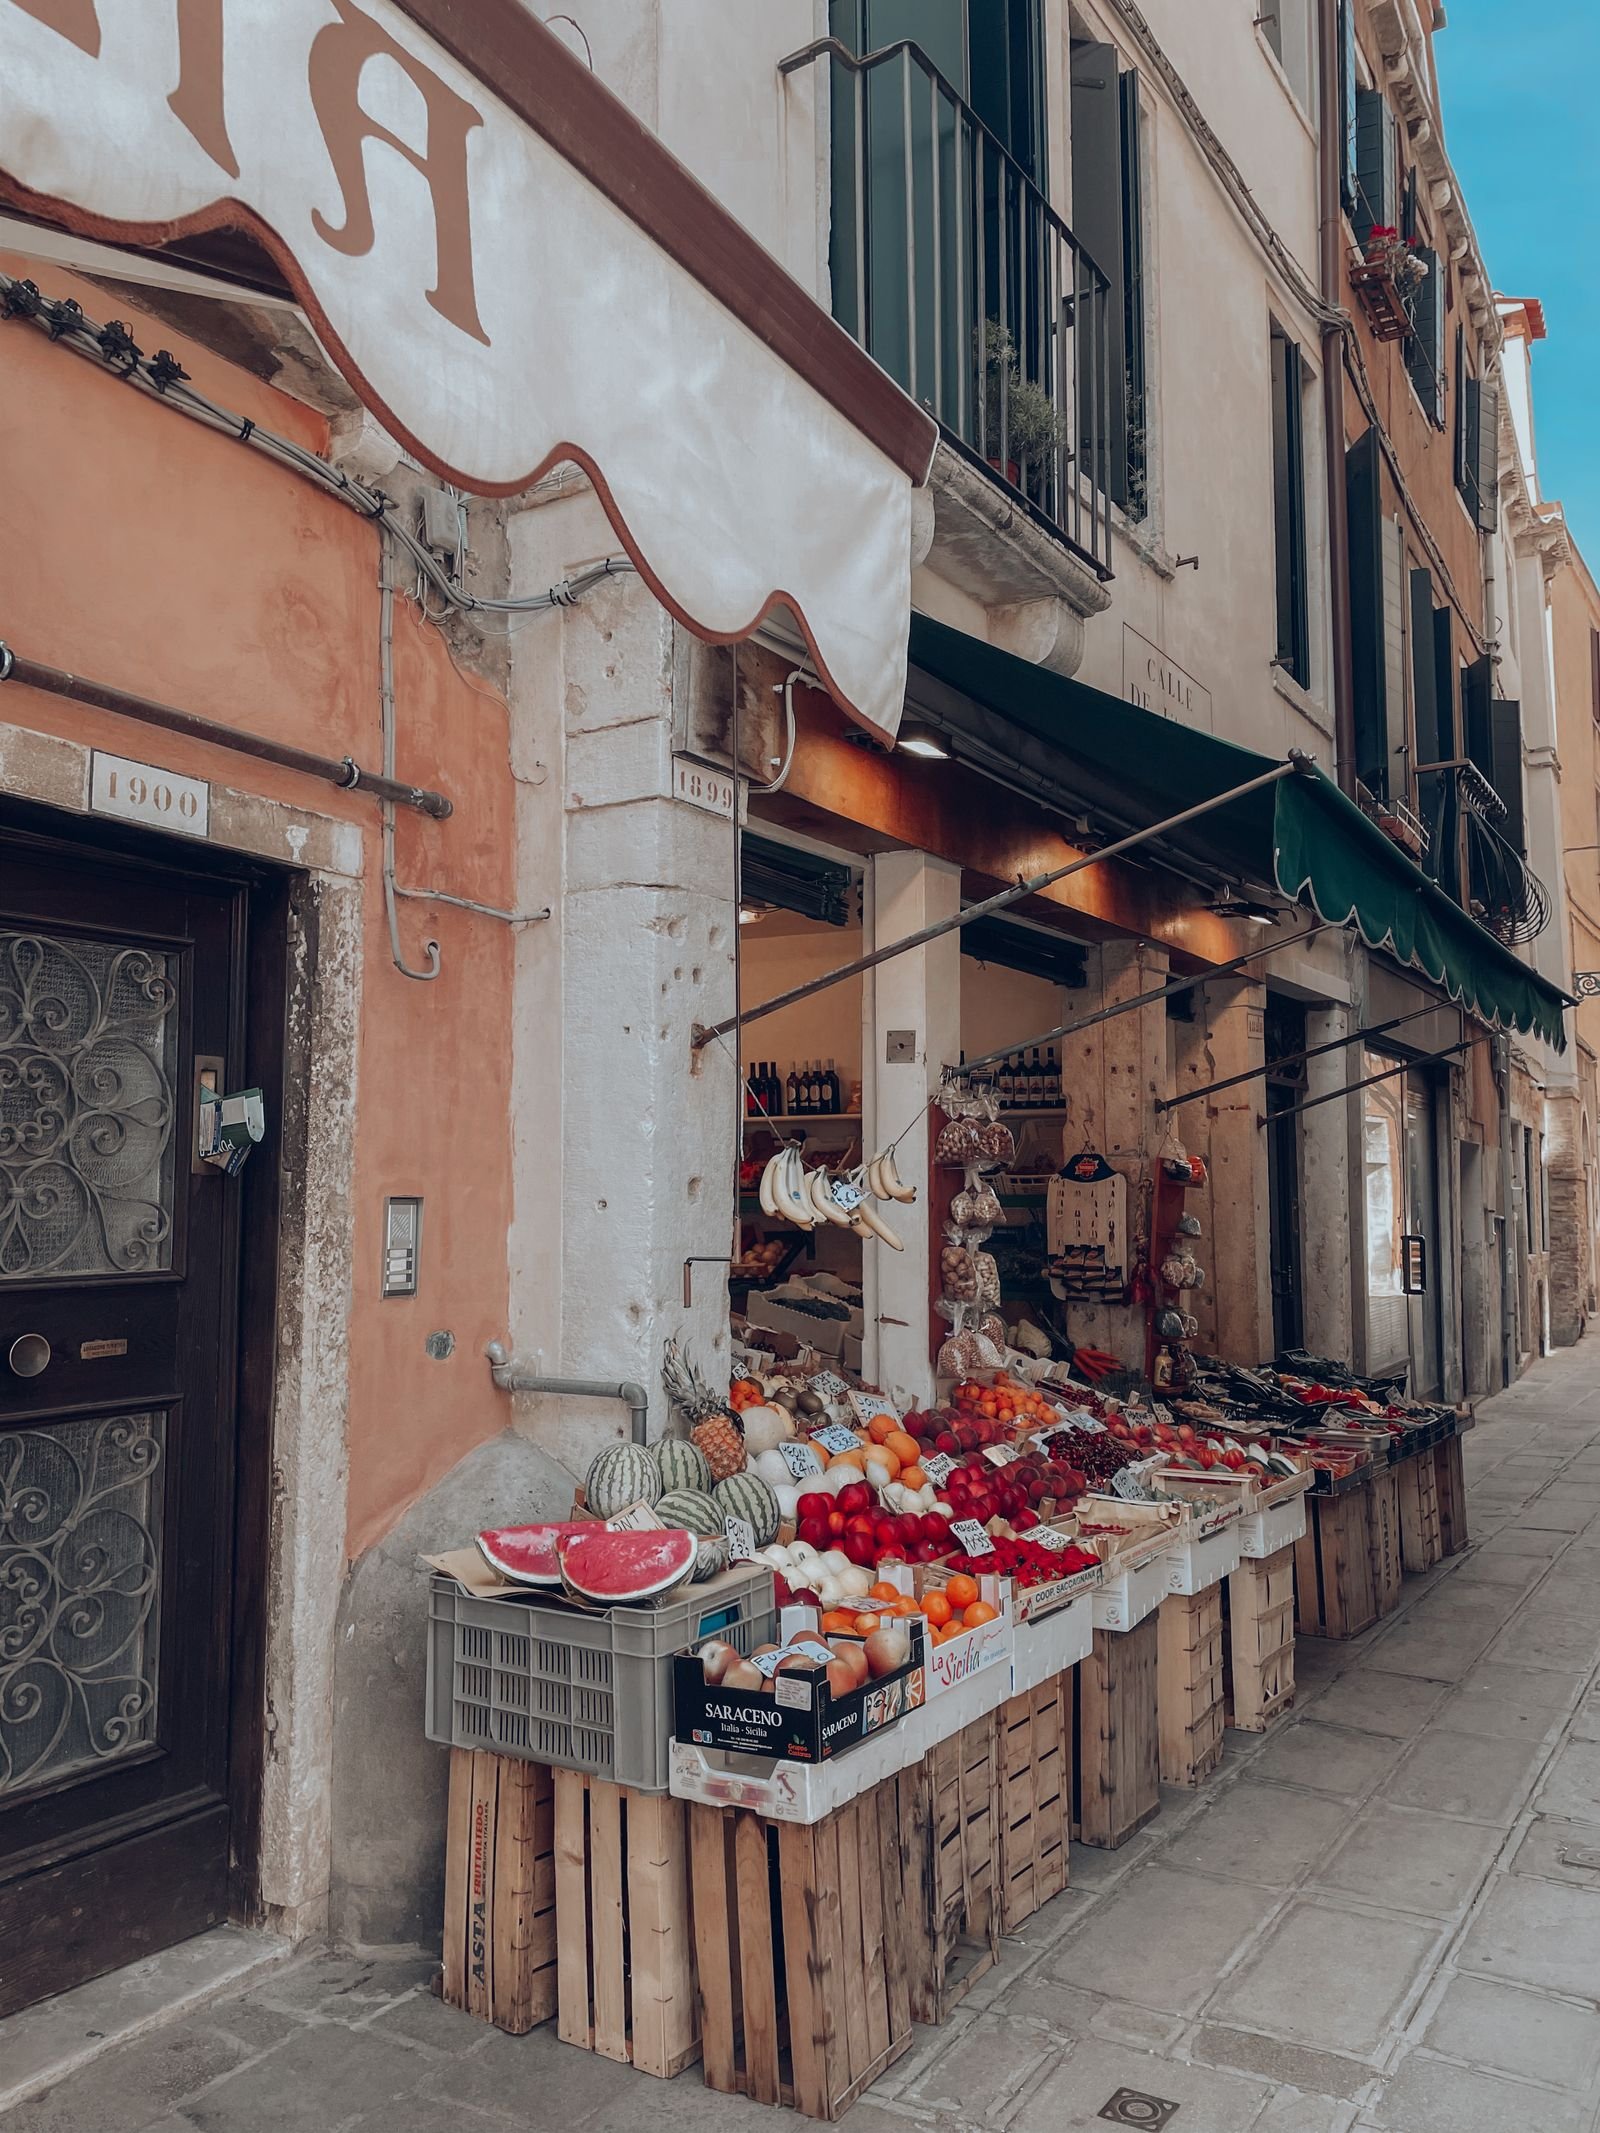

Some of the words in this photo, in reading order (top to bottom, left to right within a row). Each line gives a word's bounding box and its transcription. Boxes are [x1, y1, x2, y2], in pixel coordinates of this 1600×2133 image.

[8, 0, 491, 347] IA
[1147, 658, 1193, 712] CALLE
[107, 771, 198, 818] 1900
[680, 770, 732, 809] 1899
[1035, 1587, 1055, 1603] COOP.
[931, 1655, 944, 1673] La
[941, 1637, 980, 1686] Sicilia
[705, 1702, 783, 1728] SARACENO
[721, 1723, 740, 1734] Italia
[745, 1726, 768, 1738] Sicilia
[822, 1712, 858, 1740] SARACENO
[473, 1902, 486, 1986] ASTA
